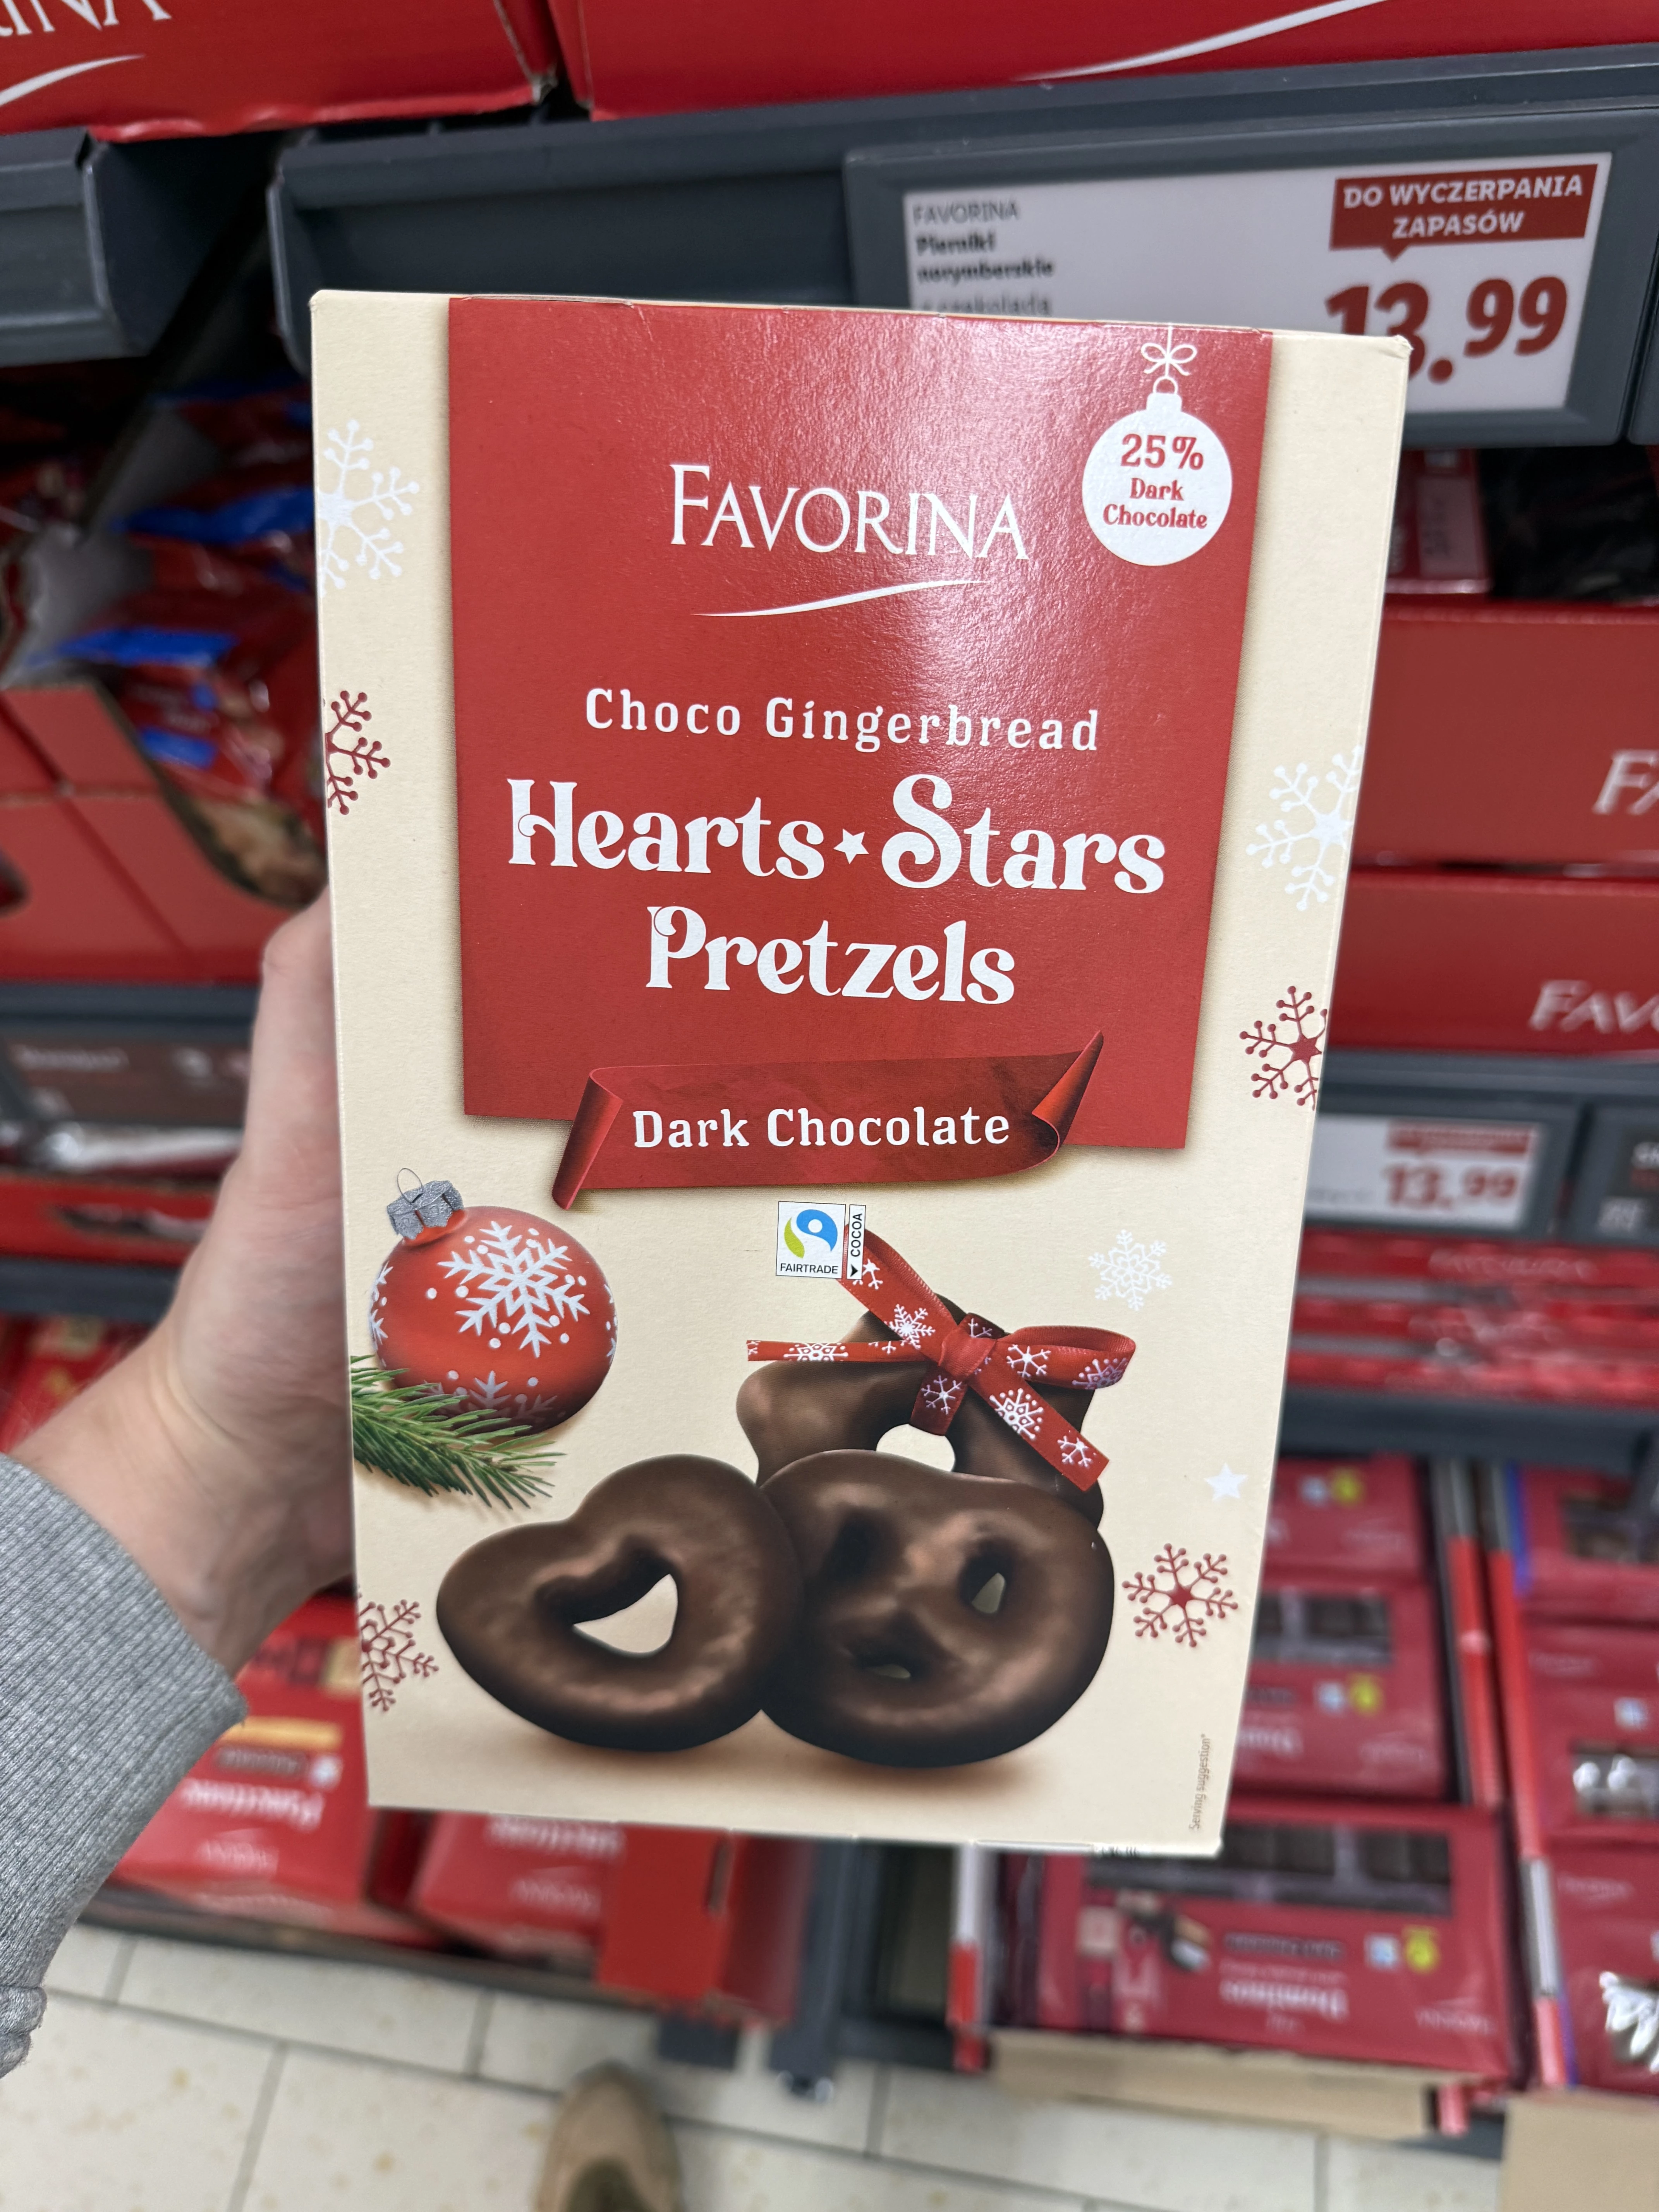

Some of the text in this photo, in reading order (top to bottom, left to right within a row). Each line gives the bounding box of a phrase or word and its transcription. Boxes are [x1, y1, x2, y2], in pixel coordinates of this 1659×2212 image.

[1343, 175, 1583, 208] DO WYCZERPANIA
[913, 198, 1019, 225] FAVORINA
[1392, 209, 1524, 239] ZAPASÓW
[1121, 433, 1204, 470] 25%
[1130, 477, 1184, 501] Dark
[670, 464, 1029, 560] FAVORINA
[1103, 504, 1207, 529] Chocolate
[586, 688, 1098, 753] Choco Gingerbread
[507, 774, 1165, 894] Hearts Stars
[645, 905, 1015, 1004] Pretzels
[1529, 980, 1659, 1034] FAV
[633, 1106, 1010, 1148] Dark Chocolate
[850, 1213, 863, 1257] COCOA
[780, 1263, 839, 1274] FAIRTRADE
[1188, 1793, 1207, 1830] Serving
